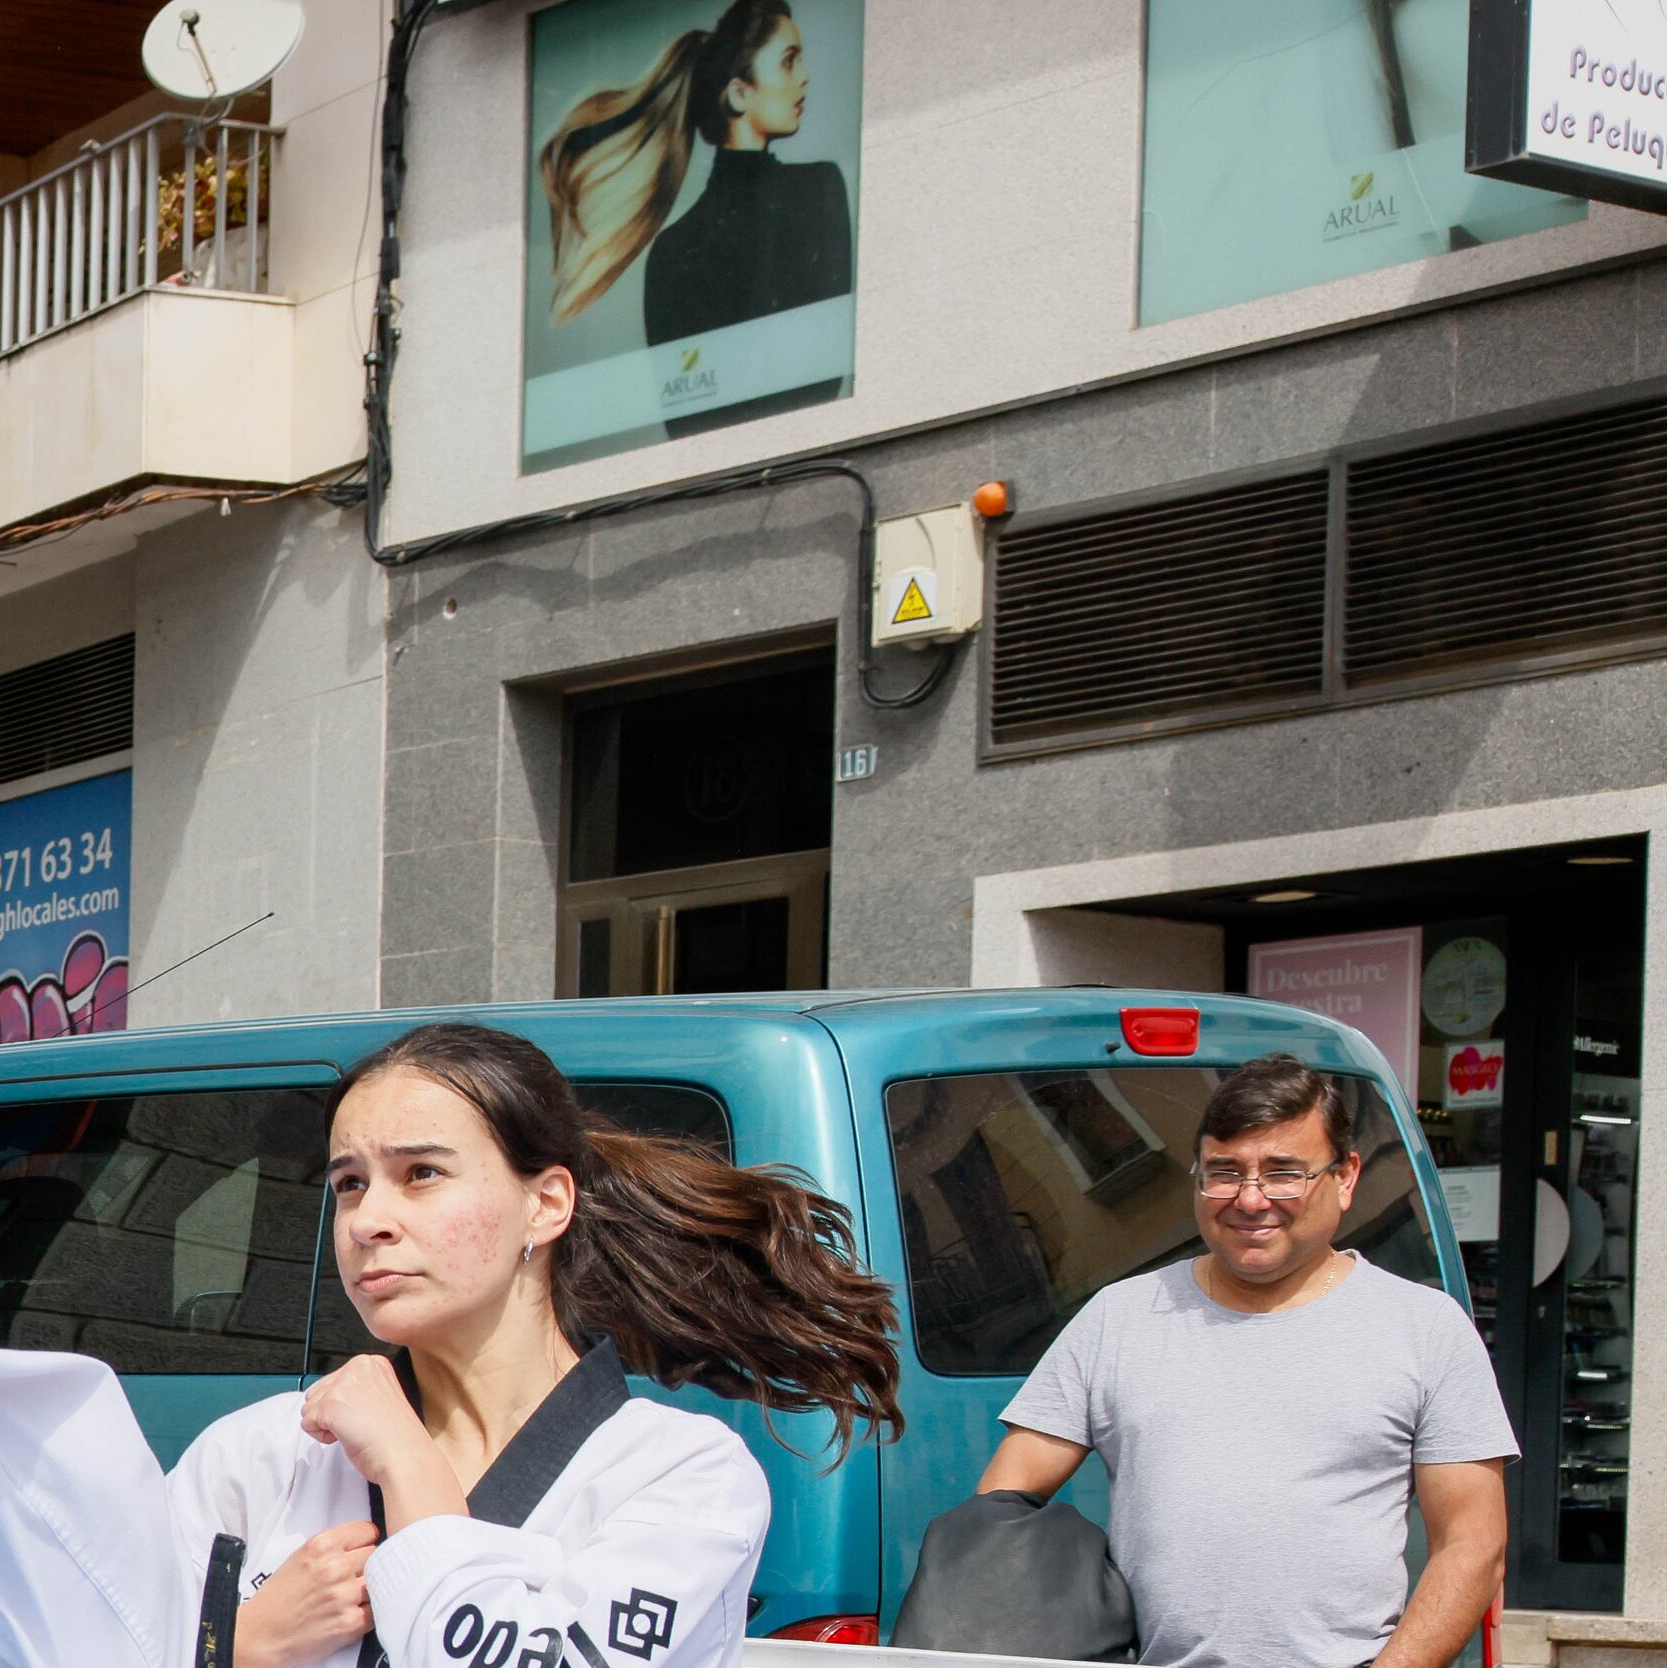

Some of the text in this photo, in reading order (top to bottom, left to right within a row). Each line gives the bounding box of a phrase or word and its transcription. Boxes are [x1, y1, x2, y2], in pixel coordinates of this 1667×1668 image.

[1570, 46, 1667, 99] Produc
[1541, 100, 1667, 170] de Peluq
[1323, 195, 1399, 233] ARUAL
[843, 750, 867, 777] 16
[40, 837, 73, 882] 63
[79, 827, 113, 874] 34
[1266, 959, 1388, 993] Descubre
